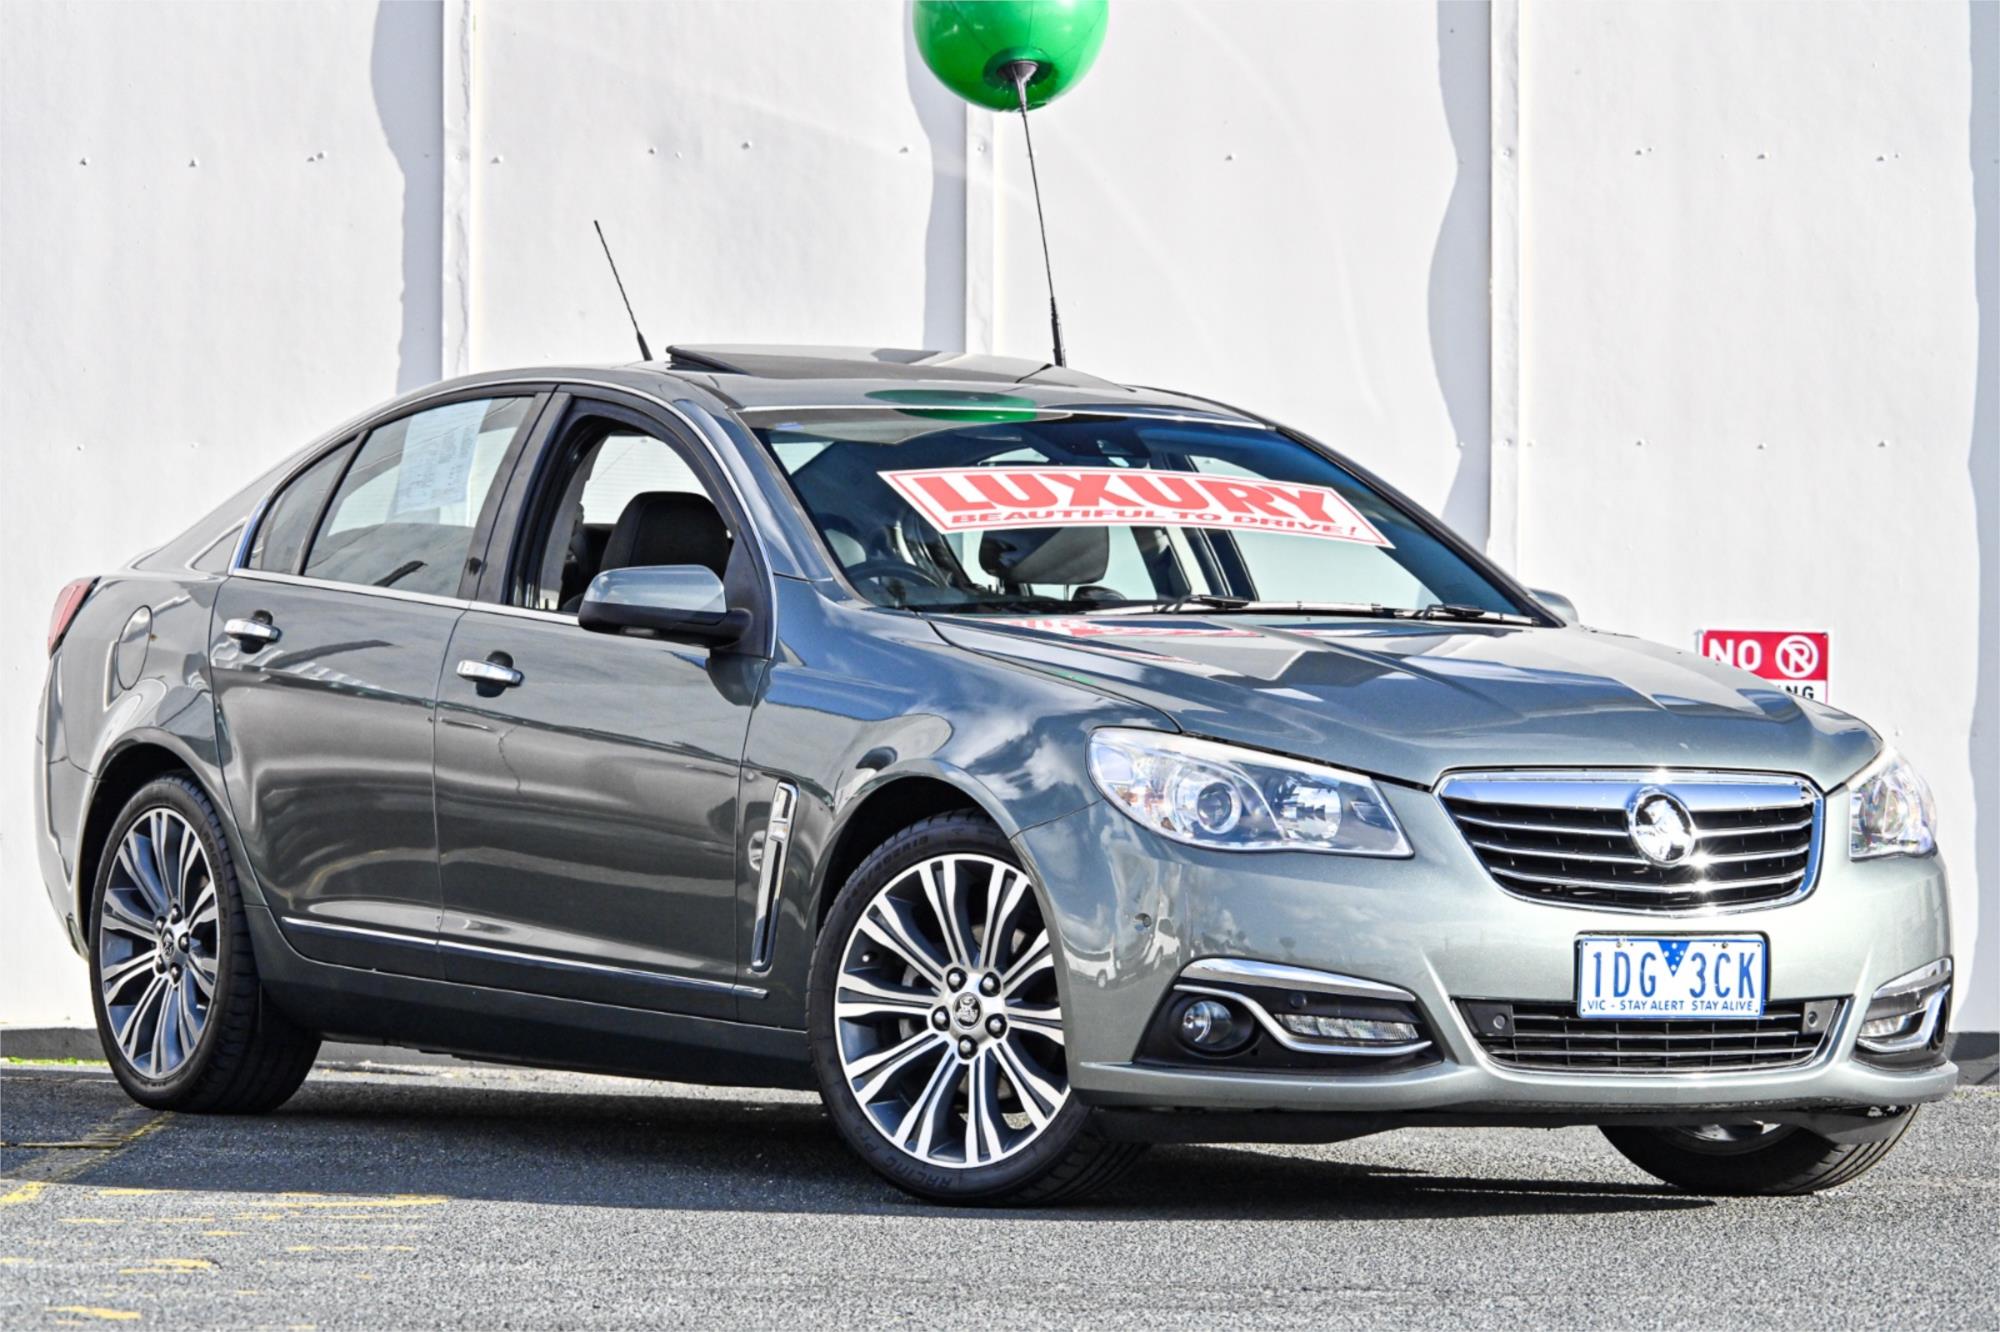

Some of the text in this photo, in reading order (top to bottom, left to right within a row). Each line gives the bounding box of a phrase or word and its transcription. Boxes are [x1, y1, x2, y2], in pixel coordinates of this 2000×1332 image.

[912, 473, 1336, 523] LUXURY
[951, 509, 1160, 524] BEAUTIFUL
[1172, 510, 1222, 521] TO
[1708, 638, 1762, 672] NO
[1593, 951, 1756, 999] 1DG 3CK
[1587, 999, 1606, 1010] VIC
[1619, 999, 1647, 1010] STAY
[1650, 999, 1684, 1011] ALERT
[1691, 999, 1719, 1011] STAY
[1721, 999, 1753, 1011] ALIVE
